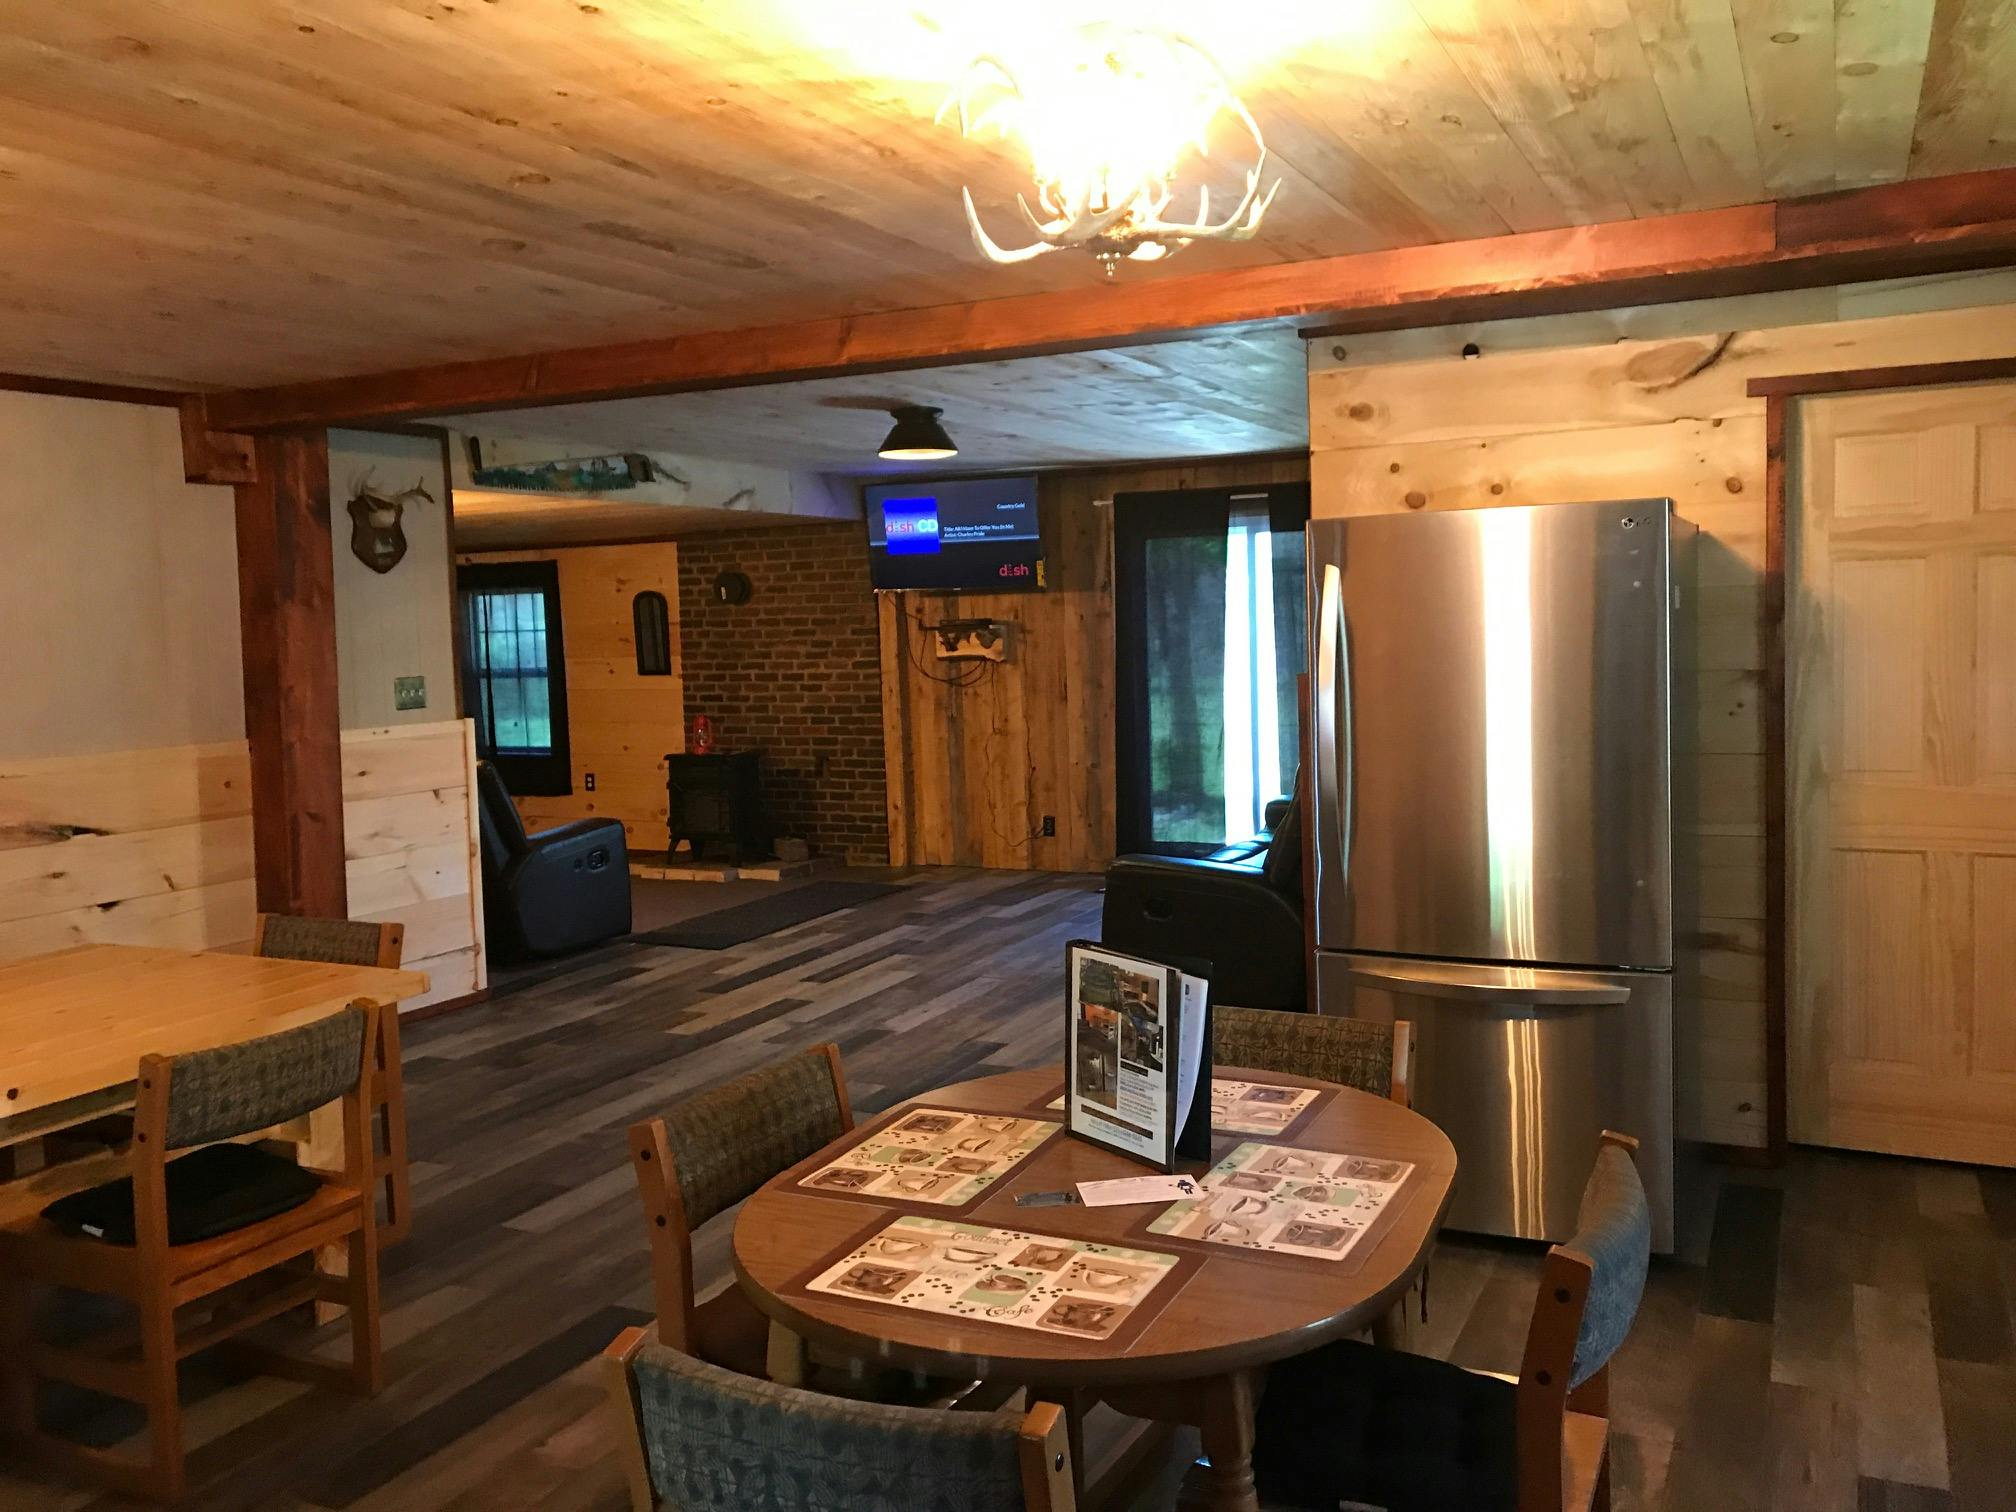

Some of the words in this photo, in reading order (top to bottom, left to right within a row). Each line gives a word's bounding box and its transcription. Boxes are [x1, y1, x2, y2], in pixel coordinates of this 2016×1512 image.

[886, 519, 914, 533] dish
[917, 518, 939, 532] CD
[999, 564, 1030, 577] dish
[950, 1231, 1012, 1247] Gourmet
